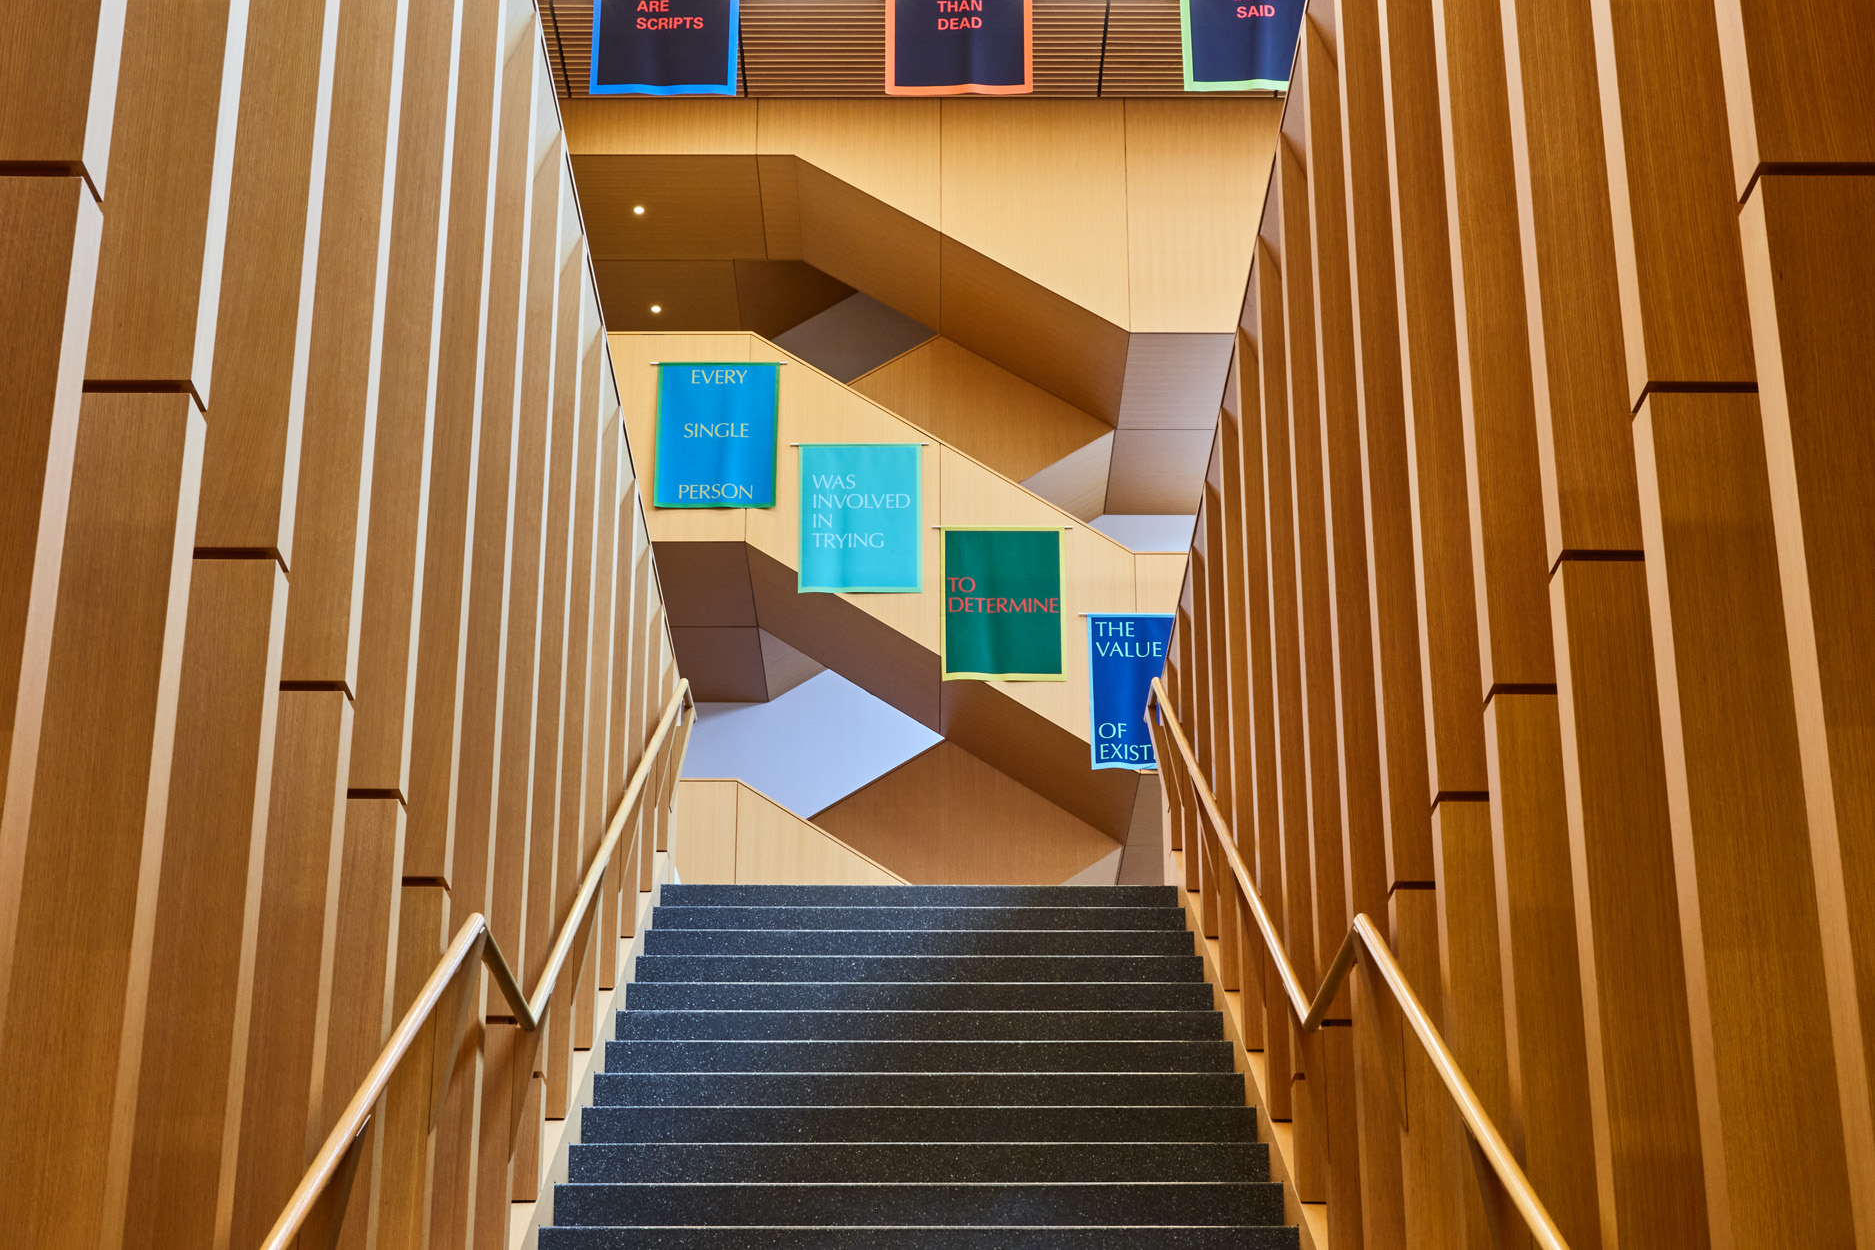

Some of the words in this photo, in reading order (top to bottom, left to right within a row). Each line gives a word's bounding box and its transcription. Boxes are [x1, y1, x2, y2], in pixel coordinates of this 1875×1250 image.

[636, 0, 670, 13] ARE
[936, 0, 983, 13] THAN
[1236, 4, 1276, 19] SAID
[636, 16, 704, 31] SCRIPTS
[937, 16, 983, 31] DEAD
[691, 369, 748, 385] EVERY
[683, 422, 749, 438] SINGLE
[812, 474, 856, 490] WAS
[678, 483, 753, 500] PERSON
[813, 493, 911, 509] INVOLVED
[812, 513, 833, 529] IN
[811, 532, 884, 549] TRYING
[947, 577, 976, 593] TO
[948, 596, 1059, 614] DETERMINE
[1095, 621, 1135, 637] THE
[1095, 641, 1162, 658] VALUE
[1098, 722, 1127, 739] OF
[1100, 743, 1156, 761] EXIST
